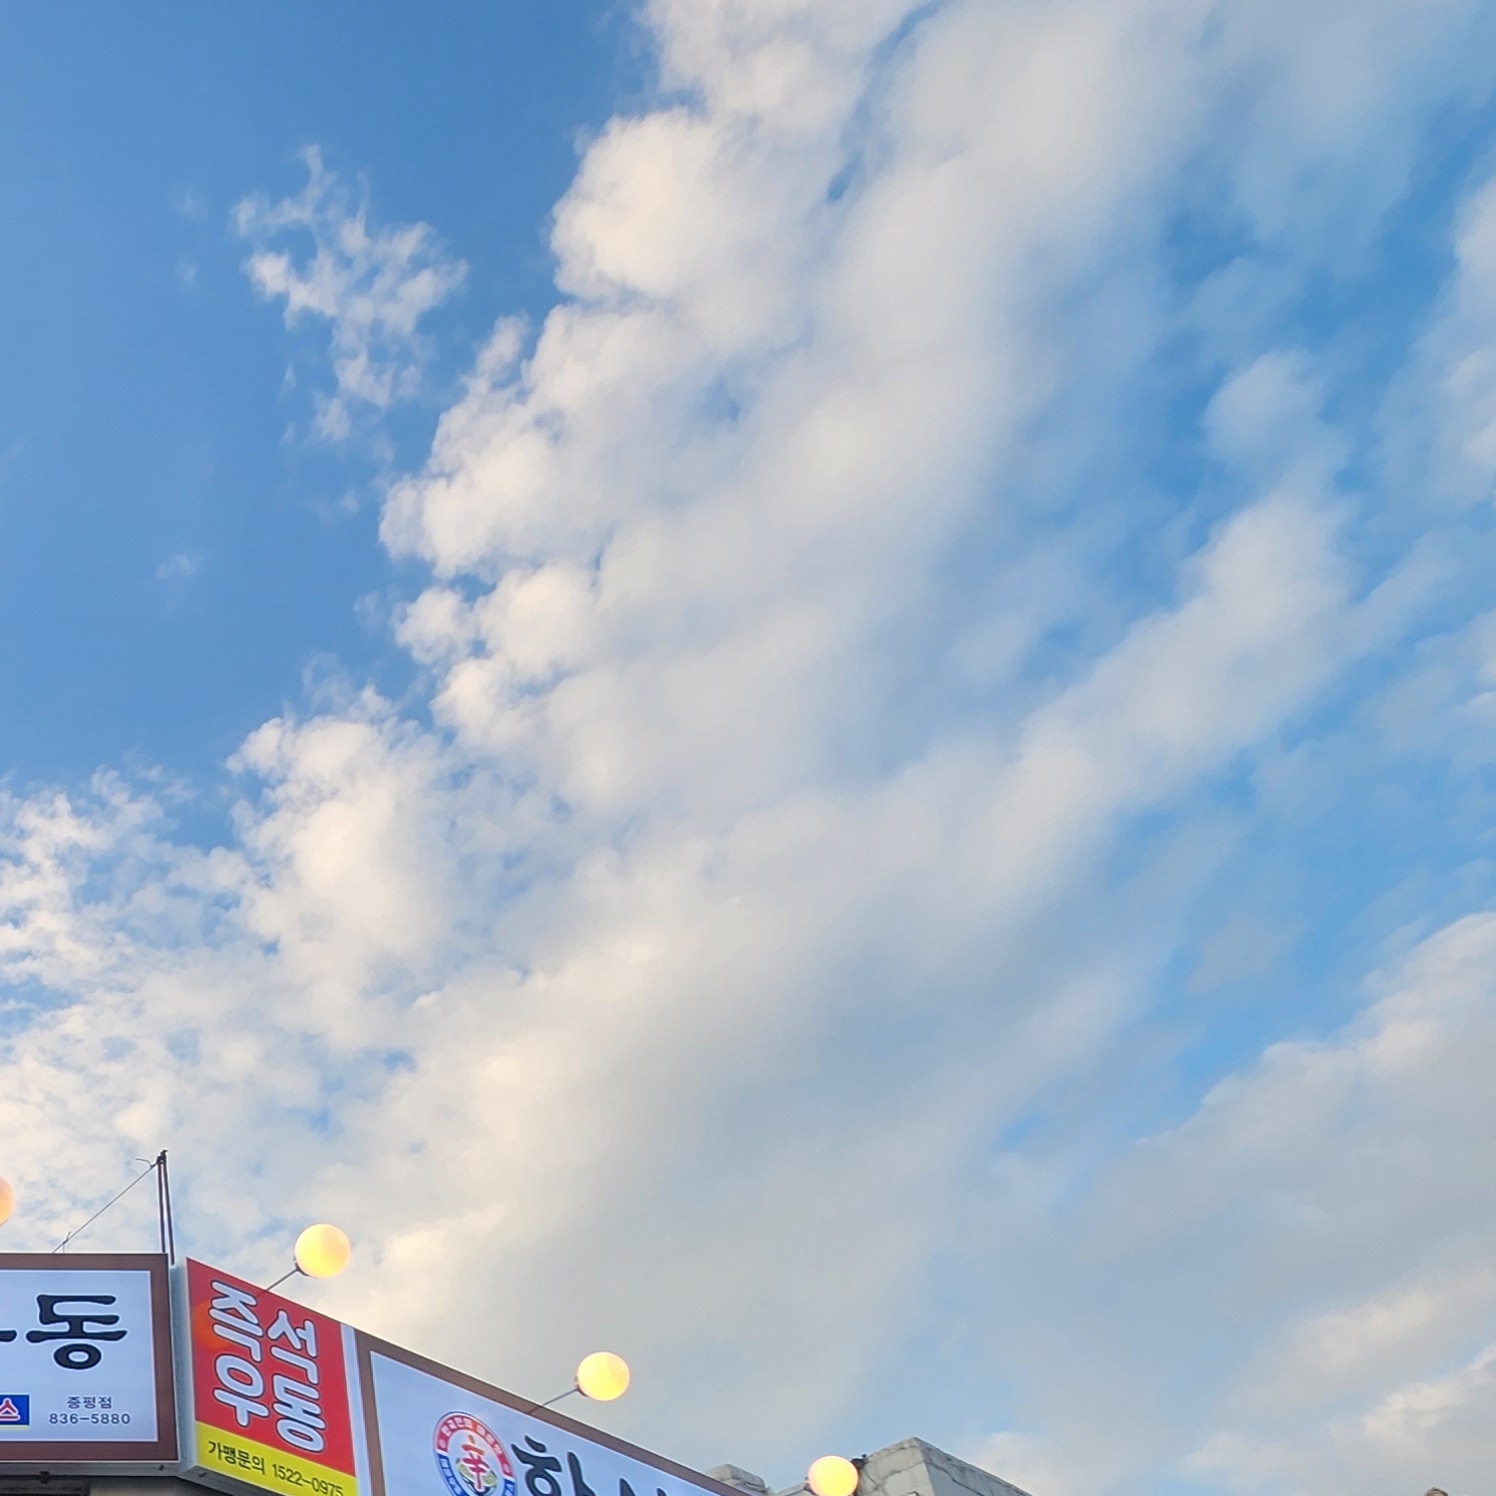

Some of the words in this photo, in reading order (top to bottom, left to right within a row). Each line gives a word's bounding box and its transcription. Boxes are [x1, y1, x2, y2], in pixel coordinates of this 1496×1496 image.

[209, 1279, 320, 1386] 즉석
[49, 1413, 131, 1425] 836-5880
[67, 1396, 113, 1409] 증평점
[213, 1356, 327, 1454] 우동
[208, 1439, 267, 1477] 가맹문의
